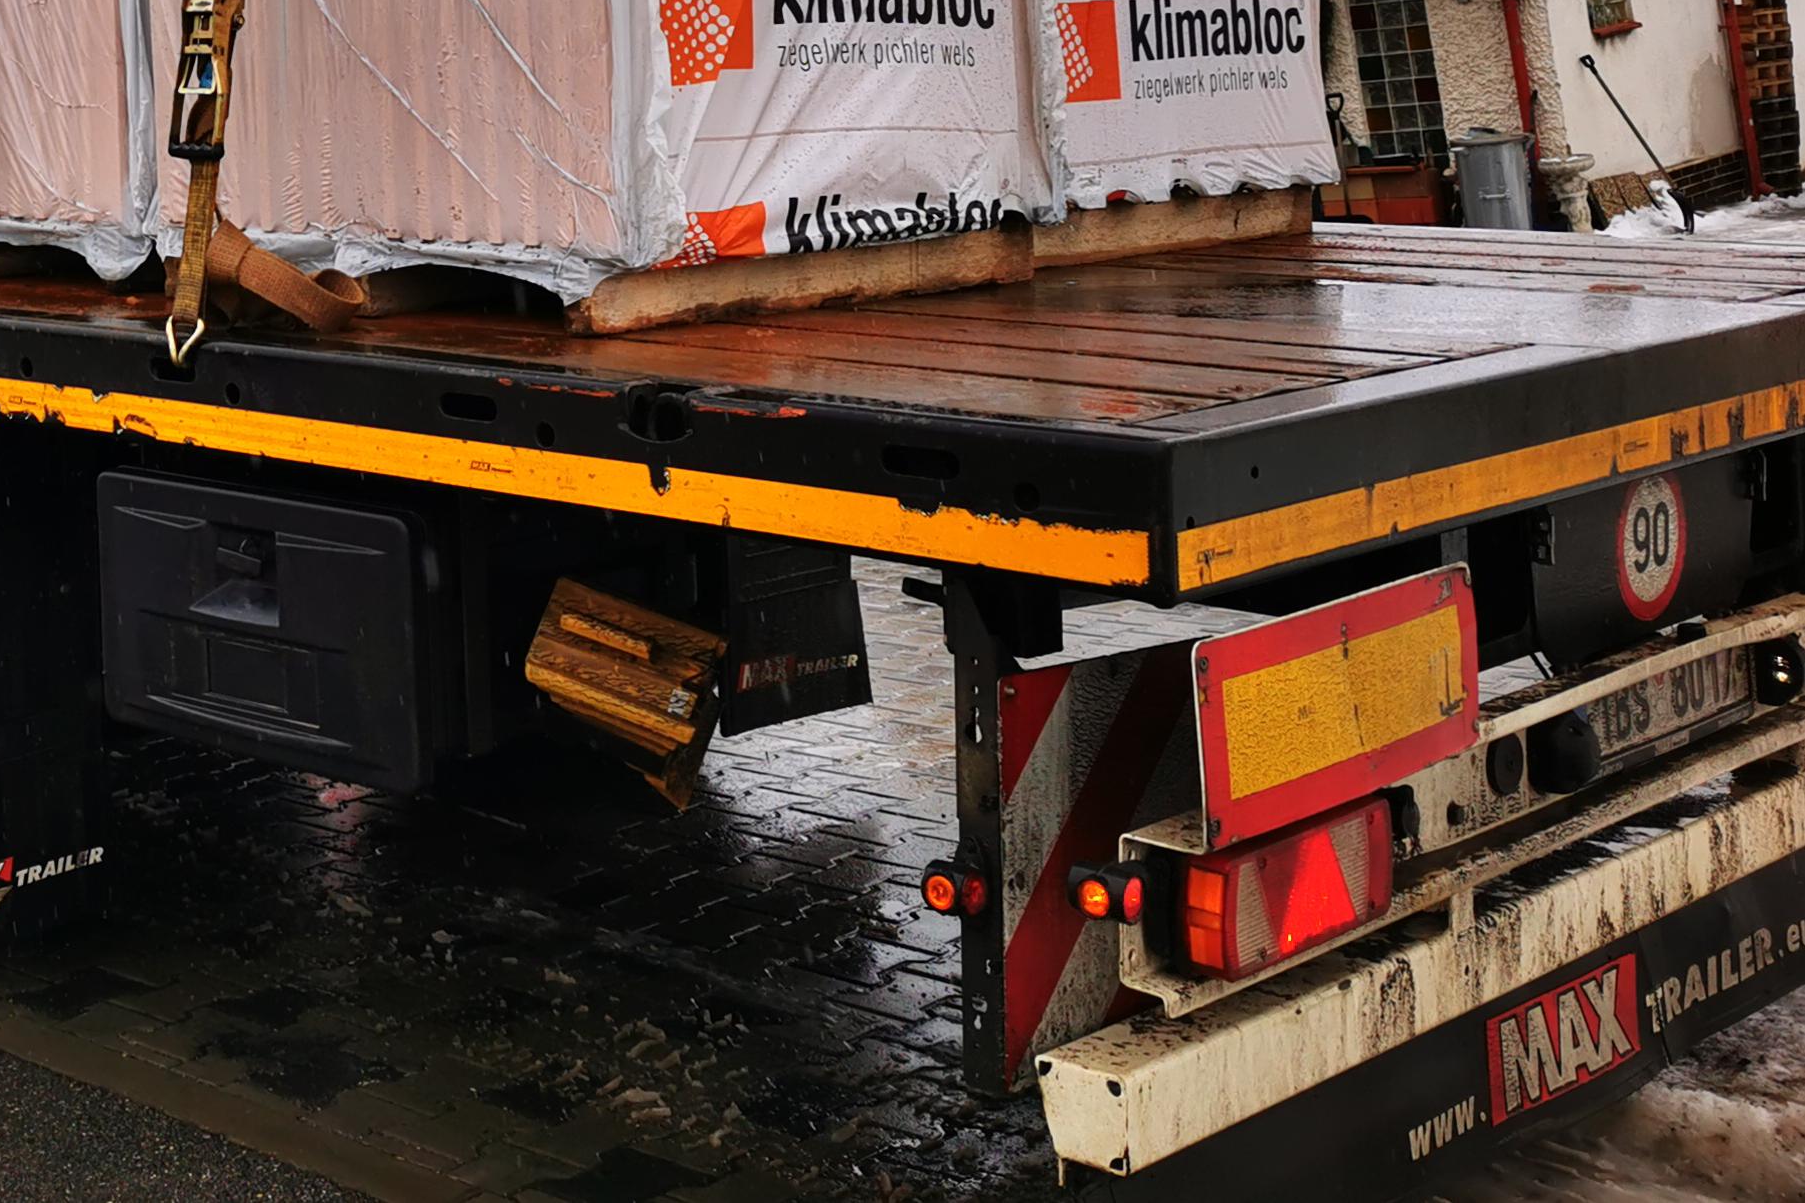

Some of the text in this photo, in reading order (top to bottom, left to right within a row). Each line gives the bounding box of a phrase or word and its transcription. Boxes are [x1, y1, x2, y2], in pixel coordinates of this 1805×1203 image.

[874, 36, 935, 70] pichler
[942, 39, 976, 67] wels
[1134, 65, 1288, 104] ziegelwerk pichler wels
[1633, 500, 1669, 574] 90
[1408, 1095, 1487, 1162] www.
[1500, 964, 1633, 1113] MAX
